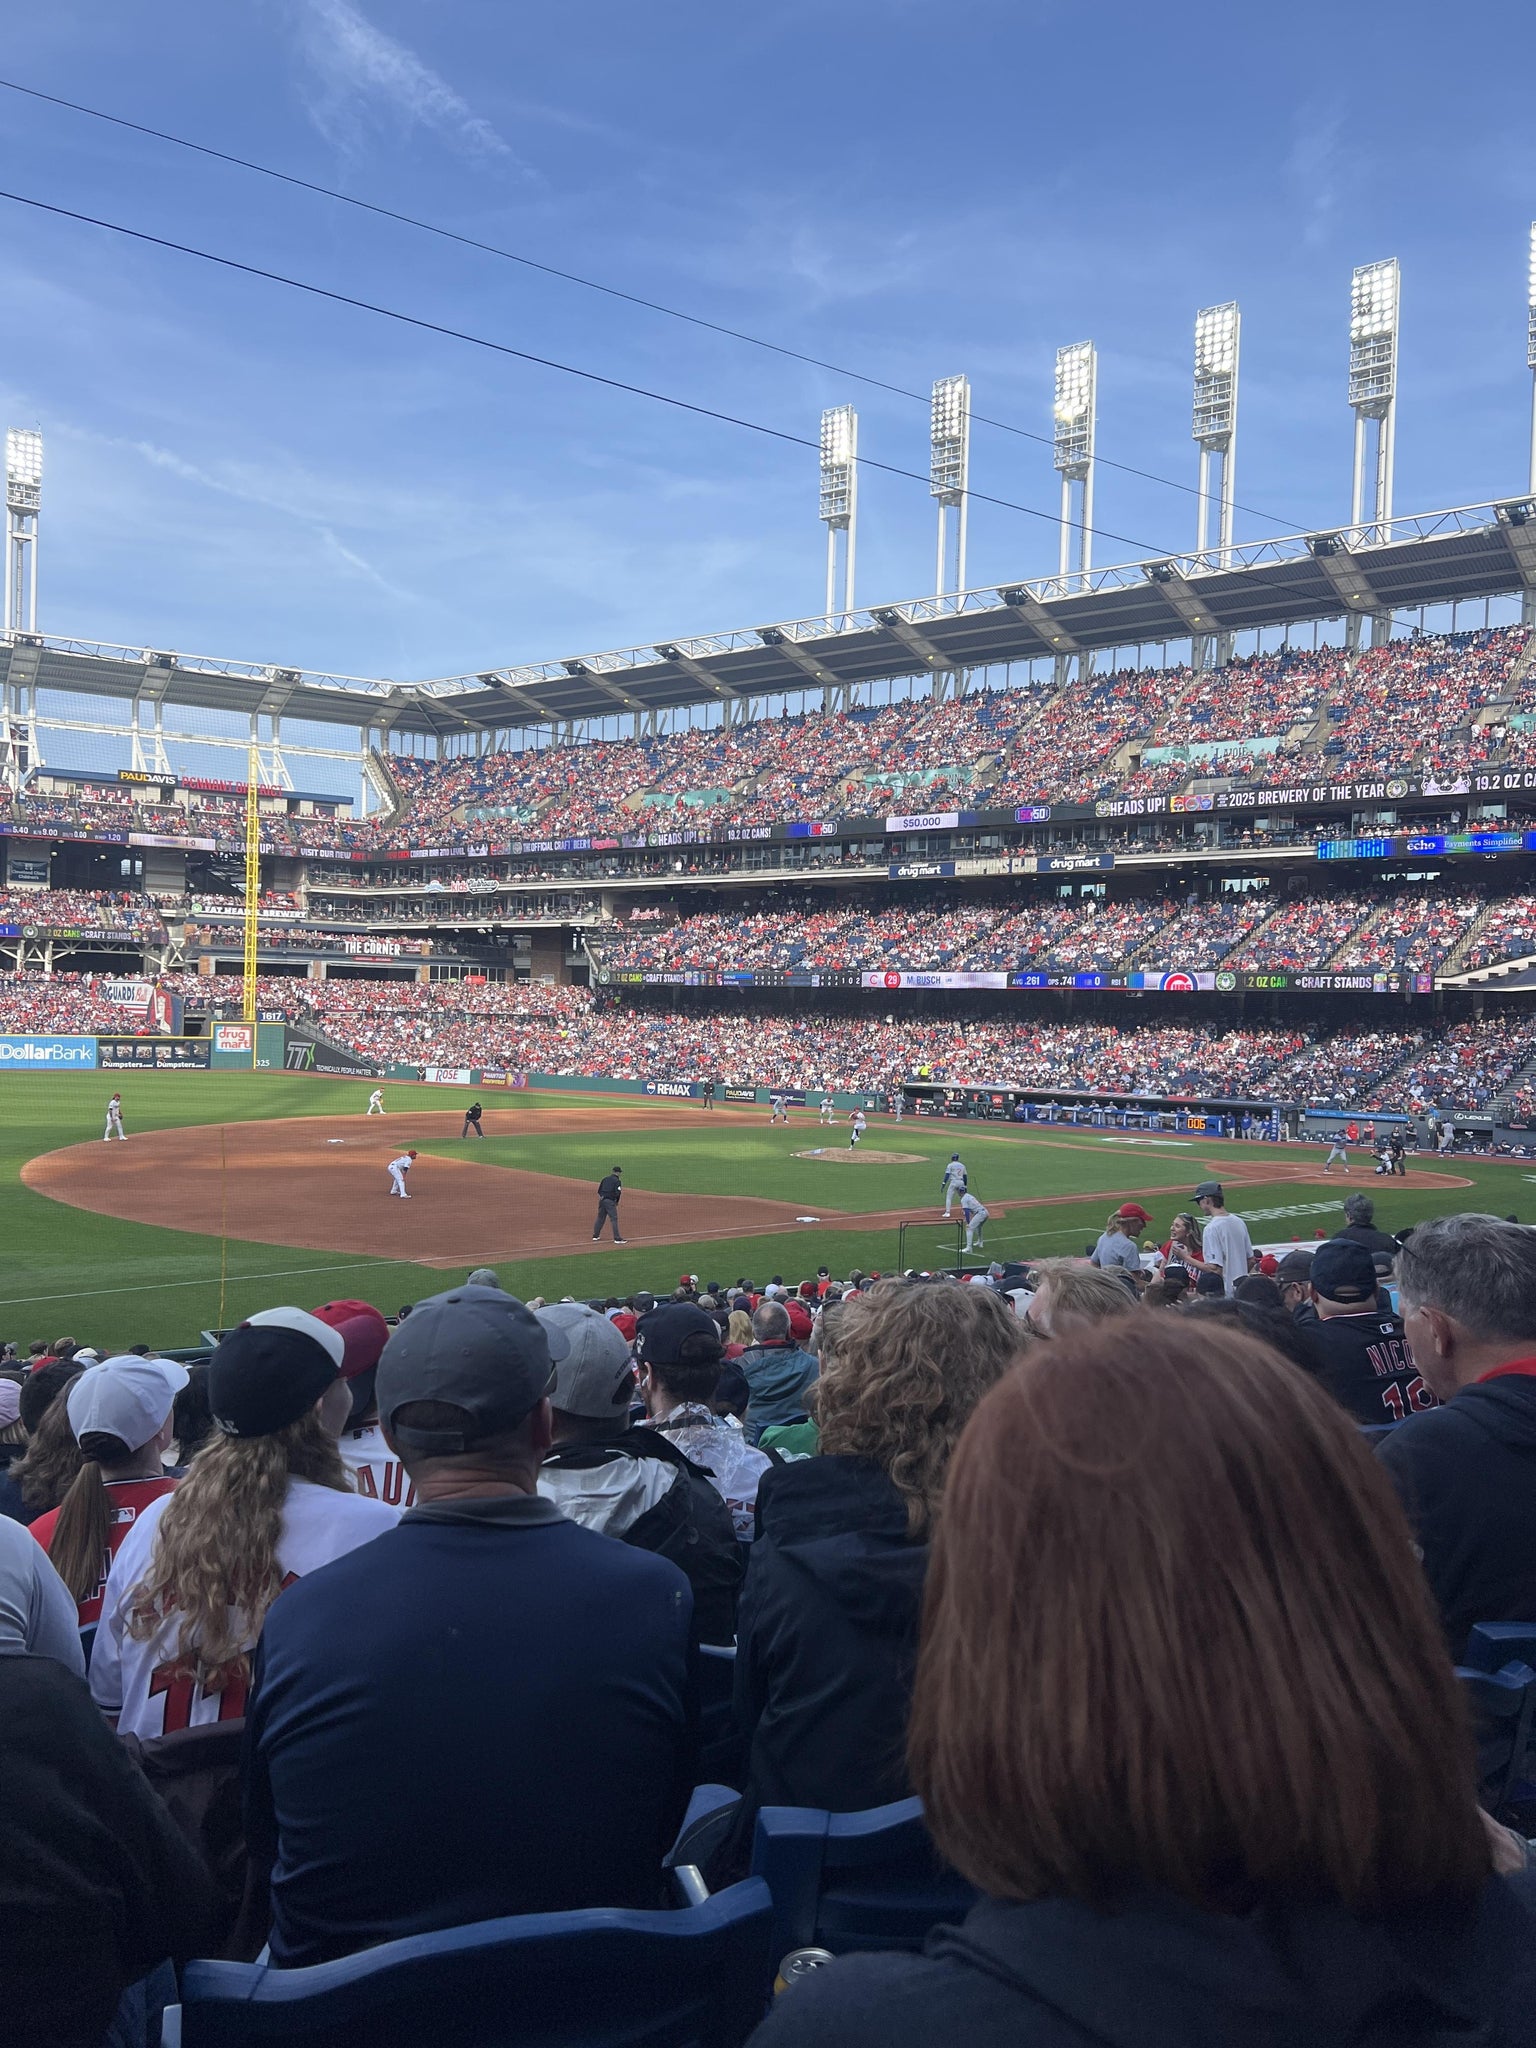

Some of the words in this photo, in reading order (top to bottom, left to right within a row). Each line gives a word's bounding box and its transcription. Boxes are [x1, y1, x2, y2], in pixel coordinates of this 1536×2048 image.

[182, 777, 232, 793] PENNANT
[236, 782, 283, 797] DIRICT
[1475, 775, 1500, 791] 19.2
[1504, 774, 1521, 789] OZ
[1229, 792, 1255, 807] 2025
[1258, 788, 1310, 805] BREWERY
[1312, 787, 1326, 801] OF
[1330, 785, 1352, 800] THE
[1355, 783, 1385, 798] YEAR
[1110, 800, 1144, 816] HEADS
[1147, 797, 1166, 813] UP!
[903, 817, 941, 829] $50,000
[108, 833, 121, 841] 1.20
[659, 833, 682, 846] HEADS
[684, 831, 697, 843] UP!
[751, 827, 771, 839] CANS!
[1407, 840, 1435, 850] echo
[1483, 836, 1523, 847] Simplified
[260, 843, 274, 854] UP!
[301, 848, 319, 857] VISIT
[319, 849, 335, 859] OUR
[1050, 860, 1074, 871] drug
[1075, 857, 1100, 867] mart
[898, 867, 919, 877] drug
[920, 865, 941, 874] mart
[451, 881, 468, 891] kids
[264, 910, 307, 918] BREWERY
[85, 930, 105, 939] CRAFT
[107, 931, 131, 940] STANDS
[345, 940, 361, 954] THE
[364, 942, 400, 956] CORNER
[663, 973, 684, 982] STANDS
[917, 976, 940, 985] BUSCH
[1024, 976, 1040, 985] .261
[1060, 976, 1076, 985] .741
[1094, 976, 1100, 985] 0
[1123, 977, 1127, 986] 1
[1257, 976, 1268, 987] OZ
[1301, 977, 1332, 988] CRAFT
[1334, 977, 1372, 988] STANDS
[262, 1012, 281, 1020] 1617
[219, 1027, 245, 1041] drug
[435, 1069, 458, 1081] ROSE
